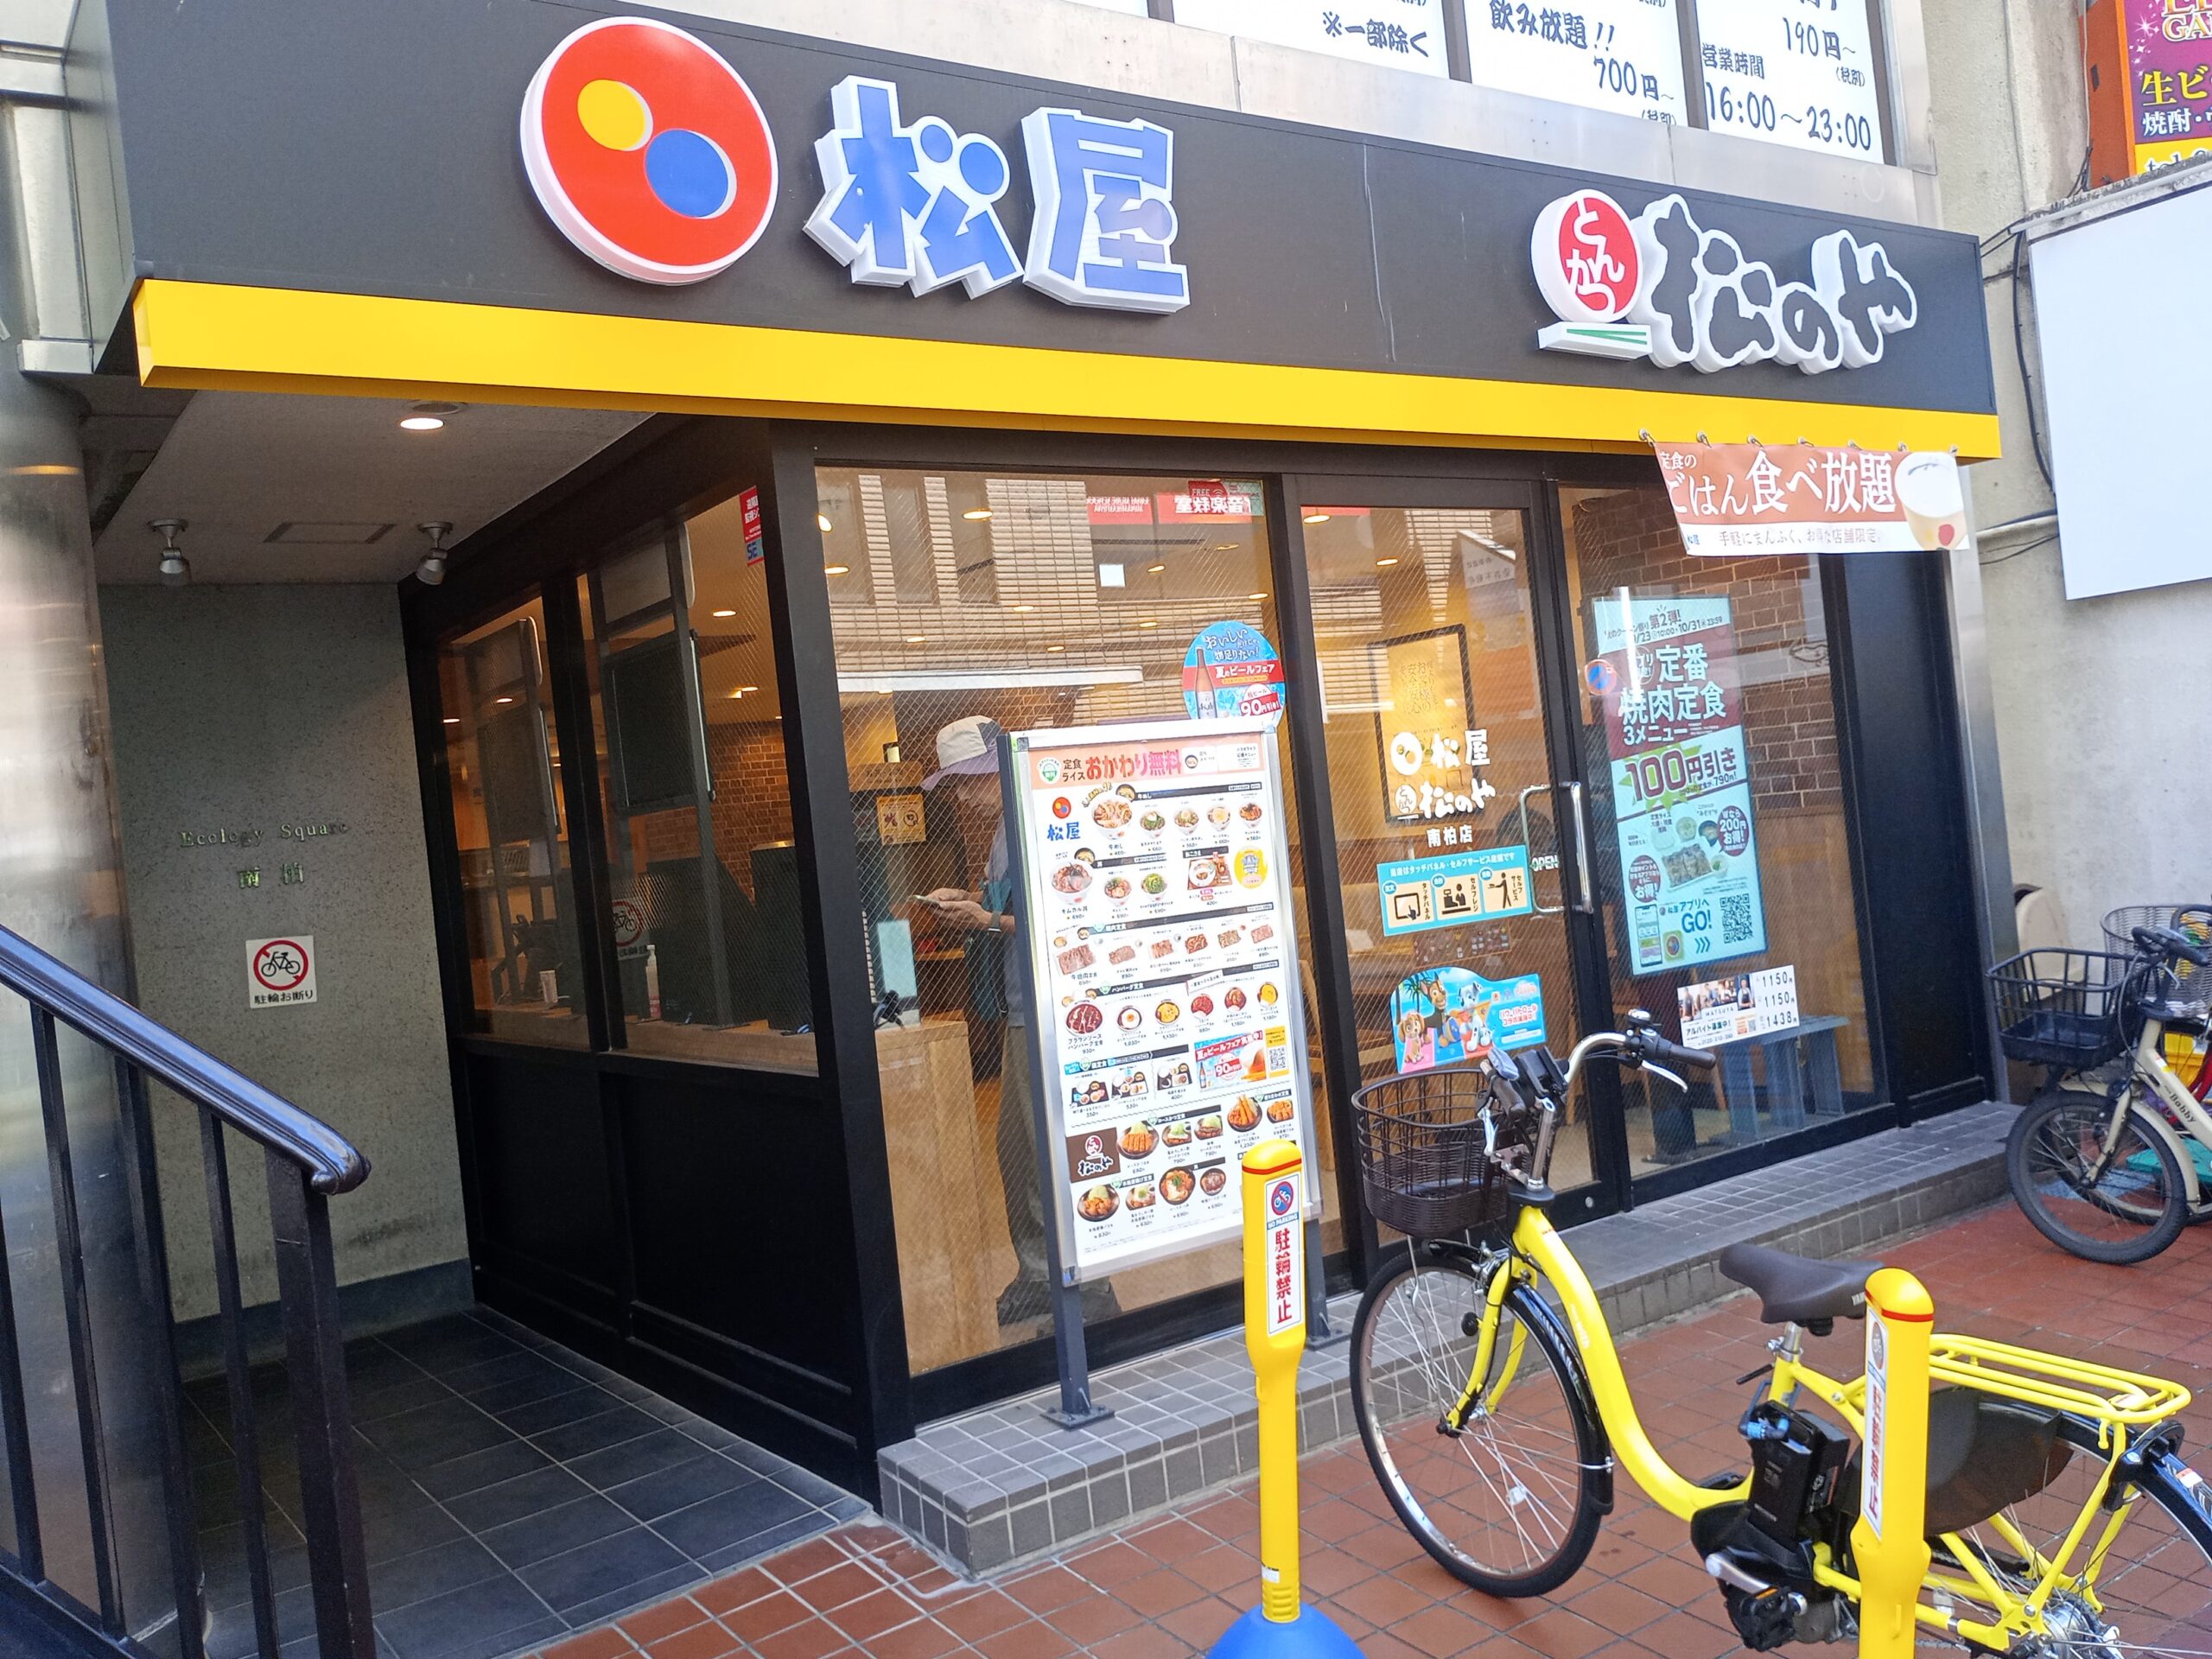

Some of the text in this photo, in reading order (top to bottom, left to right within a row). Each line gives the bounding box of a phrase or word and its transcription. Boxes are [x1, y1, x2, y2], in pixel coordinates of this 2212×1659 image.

[1322, 10, 1429, 58] ※一部除く
[1702, 42, 1765, 80] 営業時間
[817, 78, 1188, 302] 松屋
[1562, 197, 1627, 314] とんかつ
[1647, 195, 1916, 366] 松のや
[1192, 487, 1211, 497] FREE
[1655, 642, 1709, 682] 定番
[1618, 681, 1726, 725] 焼肉定食
[1430, 729, 1491, 769] 松屋
[1623, 721, 1688, 746] 3メニュー
[1061, 772, 1086, 783] ライス
[1062, 758, 1082, 771] 定食
[1084, 748, 1182, 781] おかわり無料
[1624, 747, 1738, 802] 100円引き
[1419, 778, 1497, 819] 松のや
[1046, 821, 1081, 842] 松屋
[1427, 824, 1473, 848] 南柏店
[1531, 855, 1560, 872] OPEN
[1421, 882, 1432, 921] タッチパネル
[1470, 877, 1479, 913] セルフレジ
[1510, 875, 1519, 901] サービス
[1681, 909, 1713, 933] GO!
[253, 989, 314, 1005] 駐輪お断り
[1274, 1228, 1293, 1325] 駐輪禁止
